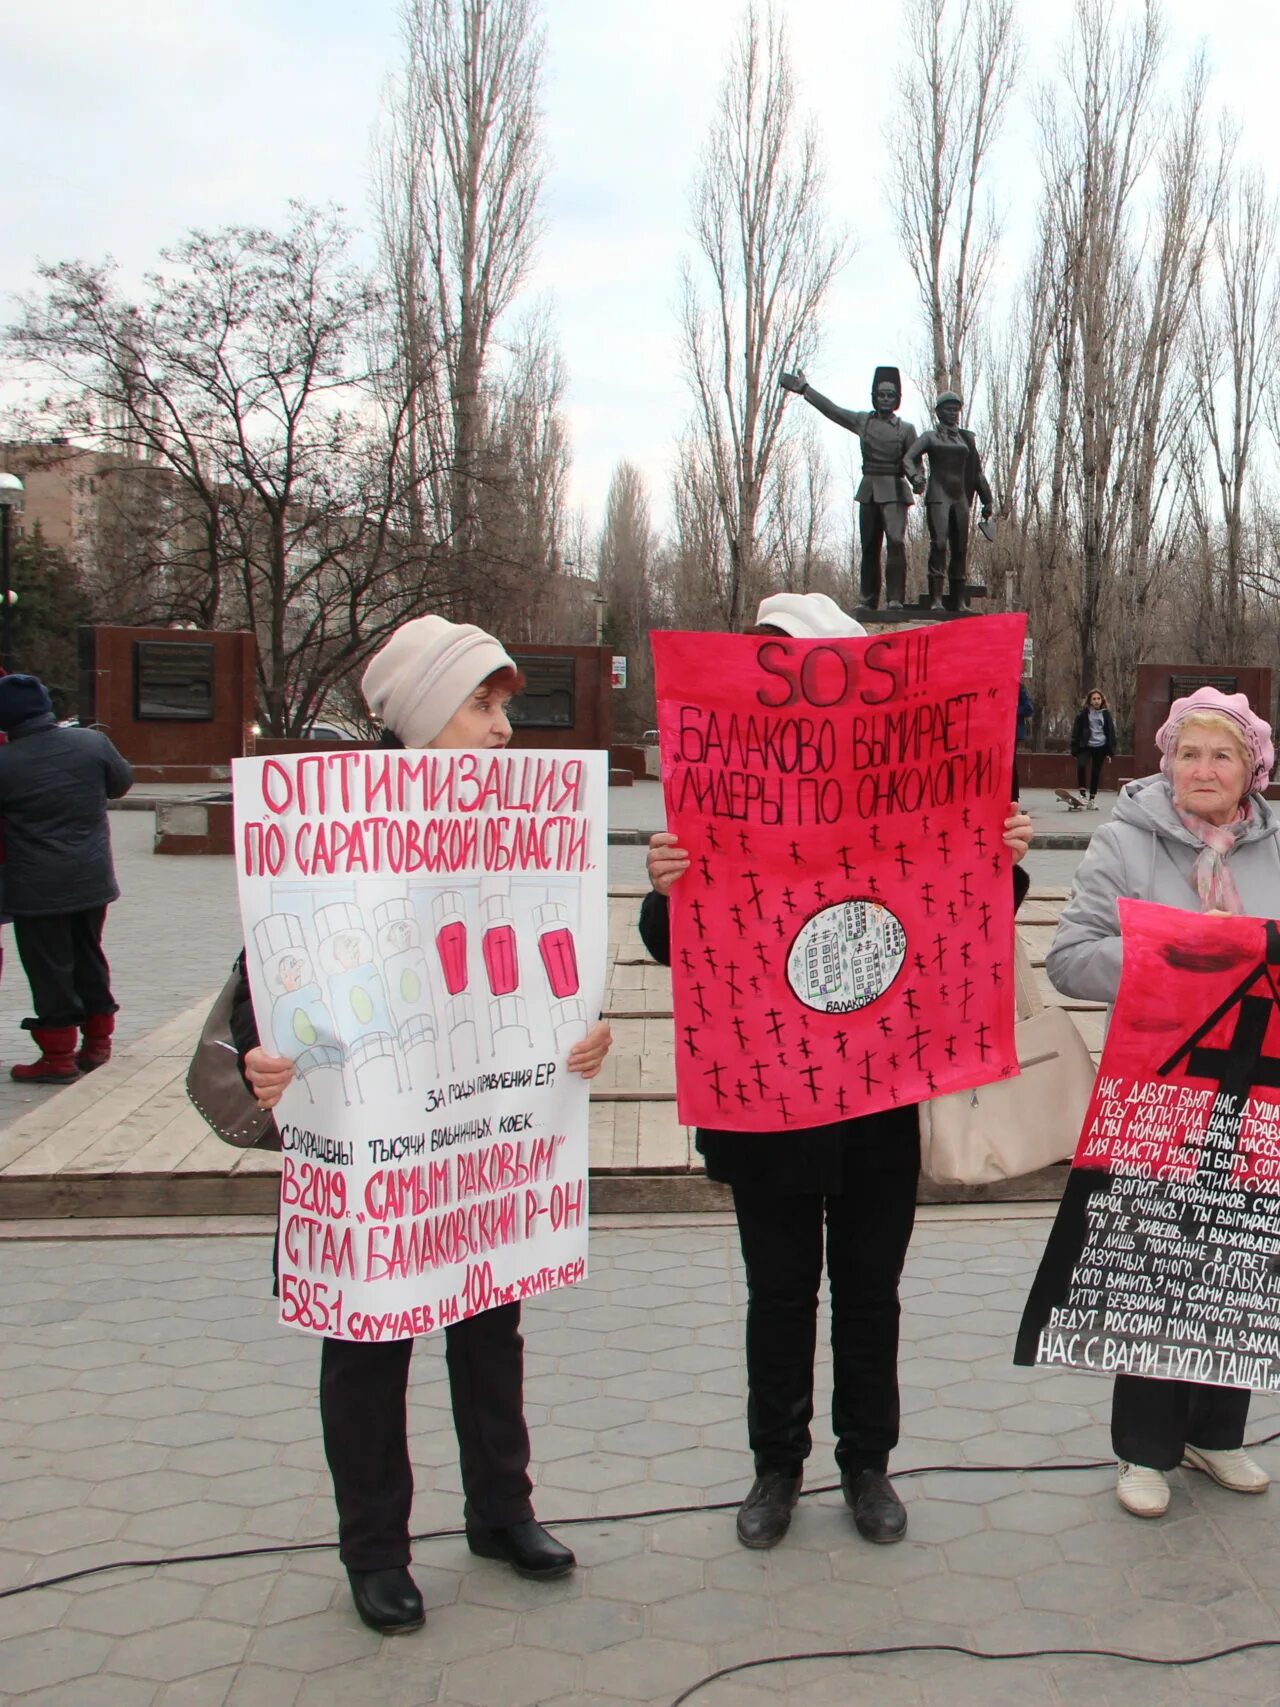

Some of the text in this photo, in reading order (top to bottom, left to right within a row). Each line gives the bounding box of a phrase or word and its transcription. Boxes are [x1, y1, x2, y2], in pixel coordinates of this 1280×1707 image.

[756, 634, 929, 707] SOS!!!
[799, 779, 843, 826] ПО
[245, 822, 286, 876] ПО
[295, 817, 479, 875] САРАТОВСКОЙ
[425, 1086, 446, 1112] ЗА
[448, 1077, 475, 1104] ГОДЫ
[476, 1069, 533, 1094] ПРАВЛЕНИЯ
[1096, 1076, 1123, 1100] НАС
[1212, 1092, 1238, 1115] НАС
[1100, 1100, 1130, 1119] ПСЫ
[1135, 1104, 1203, 1129] КАПИТАЛА
[1207, 1113, 1243, 1135] НАМИ
[1126, 1120, 1178, 1144] МОЛЧИМ!
[1184, 1126, 1236, 1150] ИНЕРТНЫ
[281, 1123, 353, 1166] СОКРАЩЕНЫ
[368, 1132, 425, 1164] ТЫСЯЧИ
[431, 1116, 493, 1152] БОЛЬНИЧНЫХ
[1083, 1137, 1110, 1157] ДЛЯ
[1111, 1139, 1163, 1162] ВЛАСТИ
[1166, 1145, 1211, 1168] МЯСОМ
[1214, 1151, 1249, 1173] БЫТЬ
[1109, 1158, 1152, 1179] ТОЛЬКО
[1157, 1164, 1240, 1192] СТАТИСТИКА
[1111, 1178, 1159, 1200] ВОПИТ,
[1164, 1183, 1246, 1209] ПОКОЙНИКОВ
[1087, 1193, 1123, 1213] НАРОД
[1131, 1198, 1186, 1221] ОЧНИСЬ!
[1192, 1204, 1212, 1224] ТЫ
[1088, 1211, 1109, 1229] ТЫ
[1112, 1215, 1131, 1232] НЕ
[1135, 1218, 1187, 1242] ЖИВЕШЬ,
[1196, 1225, 1205, 1241] А
[285, 1178, 583, 1284] СТАЛ БАЛАКОВСКИЙ Р-ОН
[1088, 1231, 1099, 1246] И
[1103, 1233, 1136, 1250] ЛИШЬ
[1144, 1237, 1208, 1260] МОЛЧАНИЕ
[1214, 1247, 1222, 1262] В
[1071, 1266, 1102, 1286] КОГО
[1105, 1272, 1164, 1294] ВИНИТЬ?
[1164, 1279, 1185, 1298] МЫ
[1188, 1284, 1224, 1303] САМИ
[1080, 1247, 1147, 1272] РАЗУМНЫХ
[1202, 1261, 1265, 1293] СМЕЛЫХ
[282, 1273, 345, 1337] 585.1
[348, 1305, 435, 1341] СЛУЧАЕВ
[439, 1295, 459, 1327] НА
[462, 1260, 493, 1319] 100
[517, 1256, 585, 1298] ЖИТЕЛЕЙ
[1068, 1288, 1103, 1306] ИТОГ
[1106, 1291, 1166, 1312] БЕЗВОЛИЯ
[1172, 1300, 1182, 1315] И
[1185, 1302, 1243, 1325] ТРУСОСТИ
[1049, 1307, 1098, 1330] ВЕДУТ
[1104, 1310, 1163, 1337] РОССИЮ
[1165, 1317, 1207, 1344] МОЛЧА
[1215, 1325, 1234, 1349] НА
[1036, 1330, 1080, 1365] НАС
[1084, 1336, 1099, 1368] С
[1102, 1338, 1160, 1374] ВАМИ
[1162, 1345, 1213, 1381] ТУПО
[1216, 1351, 1272, 1389] ТАЩАТ
